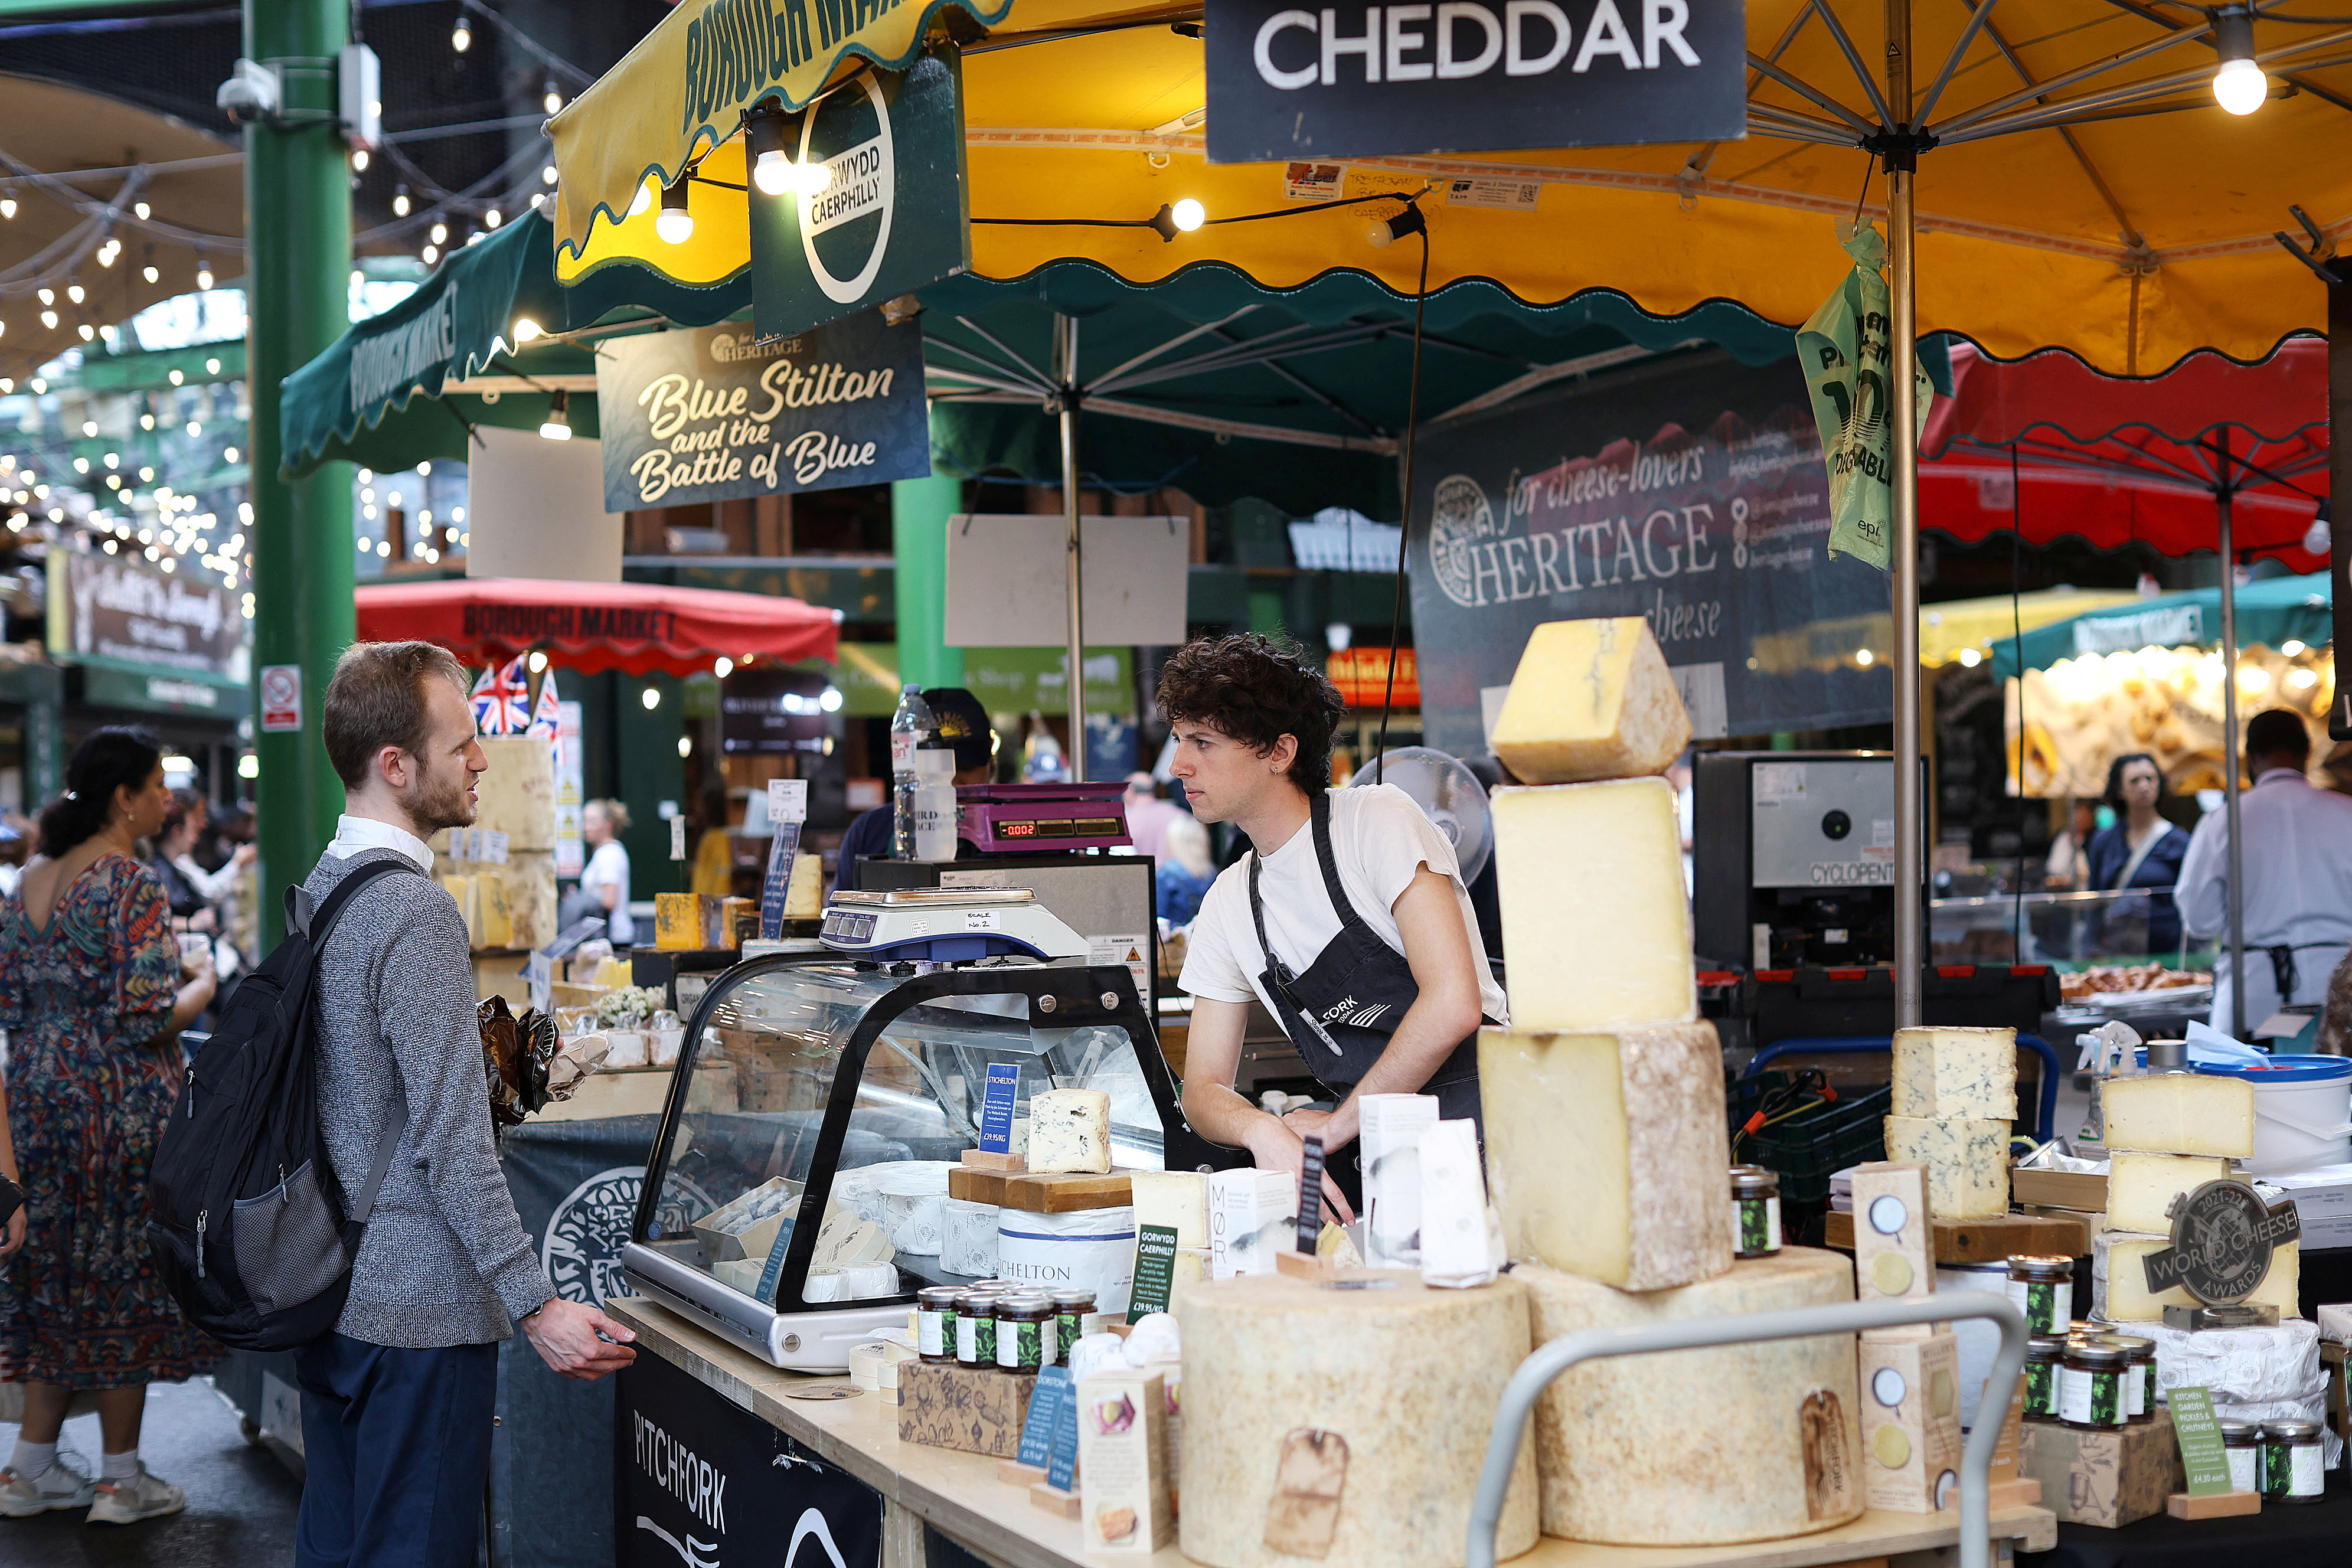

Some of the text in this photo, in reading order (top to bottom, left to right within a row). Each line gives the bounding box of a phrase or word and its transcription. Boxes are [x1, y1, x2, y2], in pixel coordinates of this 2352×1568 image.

[1253, 0, 1701, 90] CHEDDAR
[811, 177, 880, 225] CAERPHILLY
[638, 358, 895, 441] Blue Stilton
[670, 418, 771, 455] and the
[630, 430, 877, 504] Battle of Blue
[1499, 440, 1705, 537] for cheese-lovers
[1858, 518, 1880, 537] epi
[1468, 503, 1719, 608] HERITAGE
[463, 604, 677, 641] BOROUGH MARKET
[1645, 587, 1721, 643] cheese
[916, 811, 937, 819] IRD
[1811, 861, 1894, 884] CYCLOPENT
[1308, 1020, 1324, 1037] Sharpie
[988, 1076, 1016, 1085] STICHELTON
[984, 1133, 1007, 1142] £39.95/KG
[1141, 1231, 1175, 1245] GORWYDD
[2153, 1211, 2298, 1280] WORLD CHEESE
[1139, 1243, 1175, 1256] CAERPHILLY
[998, 1258, 1071, 1280] ICHELTON
[2201, 1260, 2262, 1298] AWARDS
[1133, 1302, 1164, 1313] £39.95/KG
[2175, 1391, 2202, 1401] KITCHEN
[2178, 1402, 2206, 1412] GARDEN
[2180, 1413, 2204, 1422] PICKLES
[2181, 1423, 2215, 1432] CHUTNEYS
[634, 1409, 726, 1536] PITCHFORK
[2212, 1474, 2226, 1482] each
